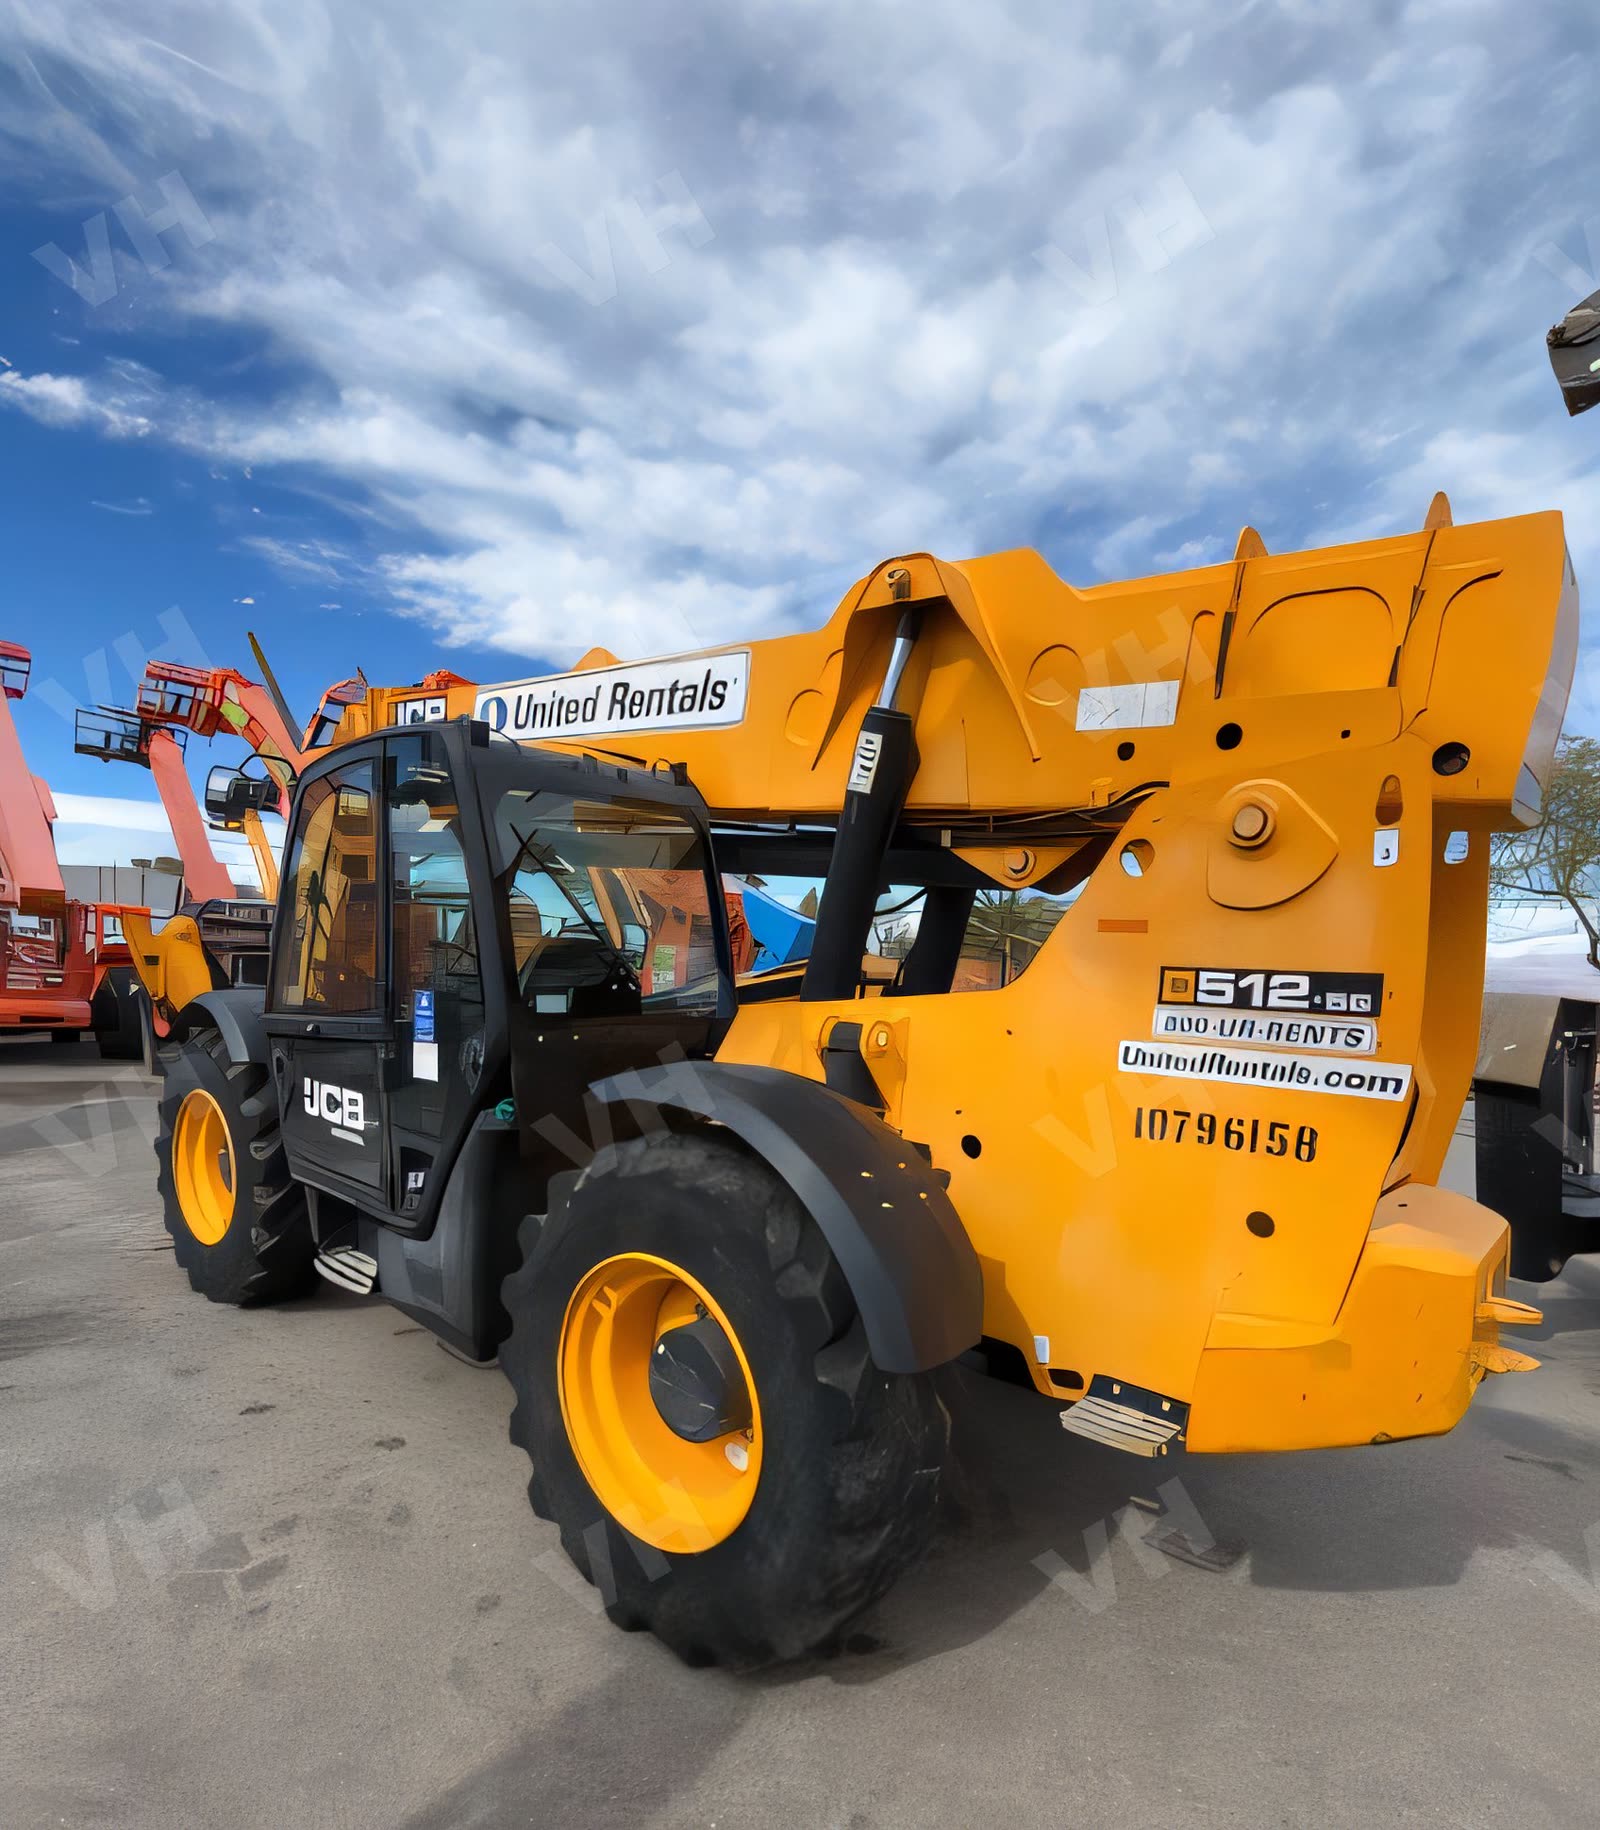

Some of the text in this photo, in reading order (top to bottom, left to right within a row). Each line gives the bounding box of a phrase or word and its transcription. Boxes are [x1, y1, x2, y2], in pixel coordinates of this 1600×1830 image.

[514, 669, 729, 729] United Rentals
[303, 1076, 365, 1131] JCB
